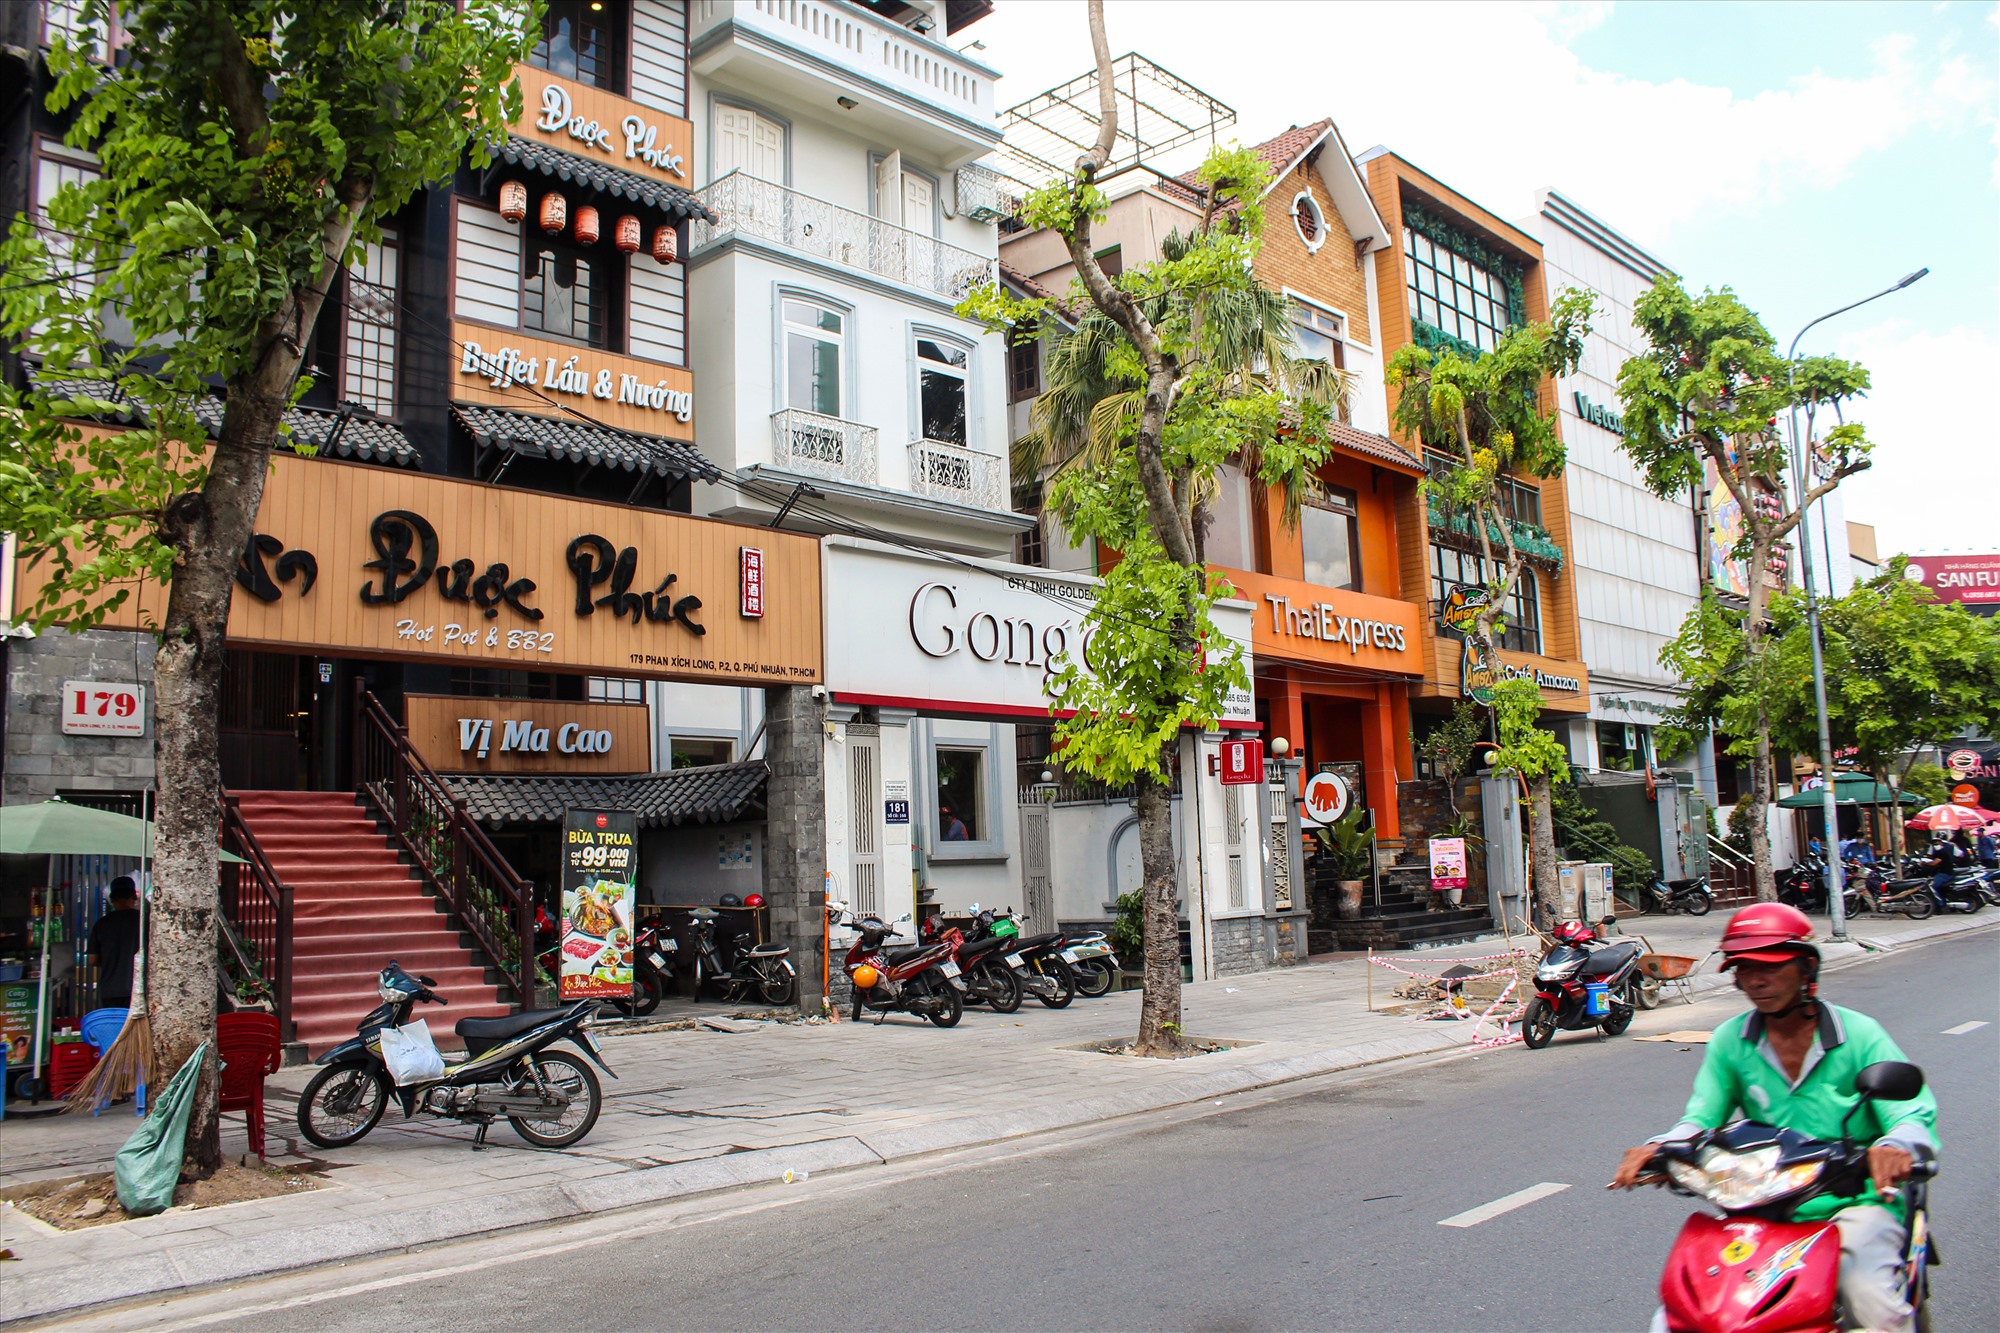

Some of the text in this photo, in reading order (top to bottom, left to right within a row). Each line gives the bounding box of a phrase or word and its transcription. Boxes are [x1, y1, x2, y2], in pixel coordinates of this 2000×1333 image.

[535, 84, 686, 178] Được Phúc
[460, 341, 539, 388] Buffet
[592, 369, 614, 399] &
[617, 373, 693, 423] Nướng
[1573, 391, 1626, 436] Vietco
[359, 509, 544, 619] Được
[566, 533, 706, 636] Phúc
[1936, 571, 1999, 587] SAN FU
[1008, 577, 1028, 590] CTY
[1029, 580, 1056, 597] TNHH
[396, 619, 435, 642] Hot
[444, 623, 479, 646] Pot
[485, 626, 499, 647] &
[1264, 592, 1406, 656] ThaiExpress
[908, 581, 1072, 699] Gong
[630, 653, 644, 664] 179
[645, 655, 669, 666] PHAN
[671, 654, 691, 668] XÍCH
[692, 659, 717, 672] LONG,
[733, 662, 742, 673] Q.
[743, 661, 759, 673] PHÚ
[789, 667, 816, 678] TP.HCM
[1536, 669, 1580, 691] Amazon
[72, 690, 136, 717] 179
[1236, 694, 1250, 703] 6339
[457, 718, 613, 759] Vị Ma Cao
[889, 802, 905, 813] 181
[597, 832, 633, 846] TRƯA
